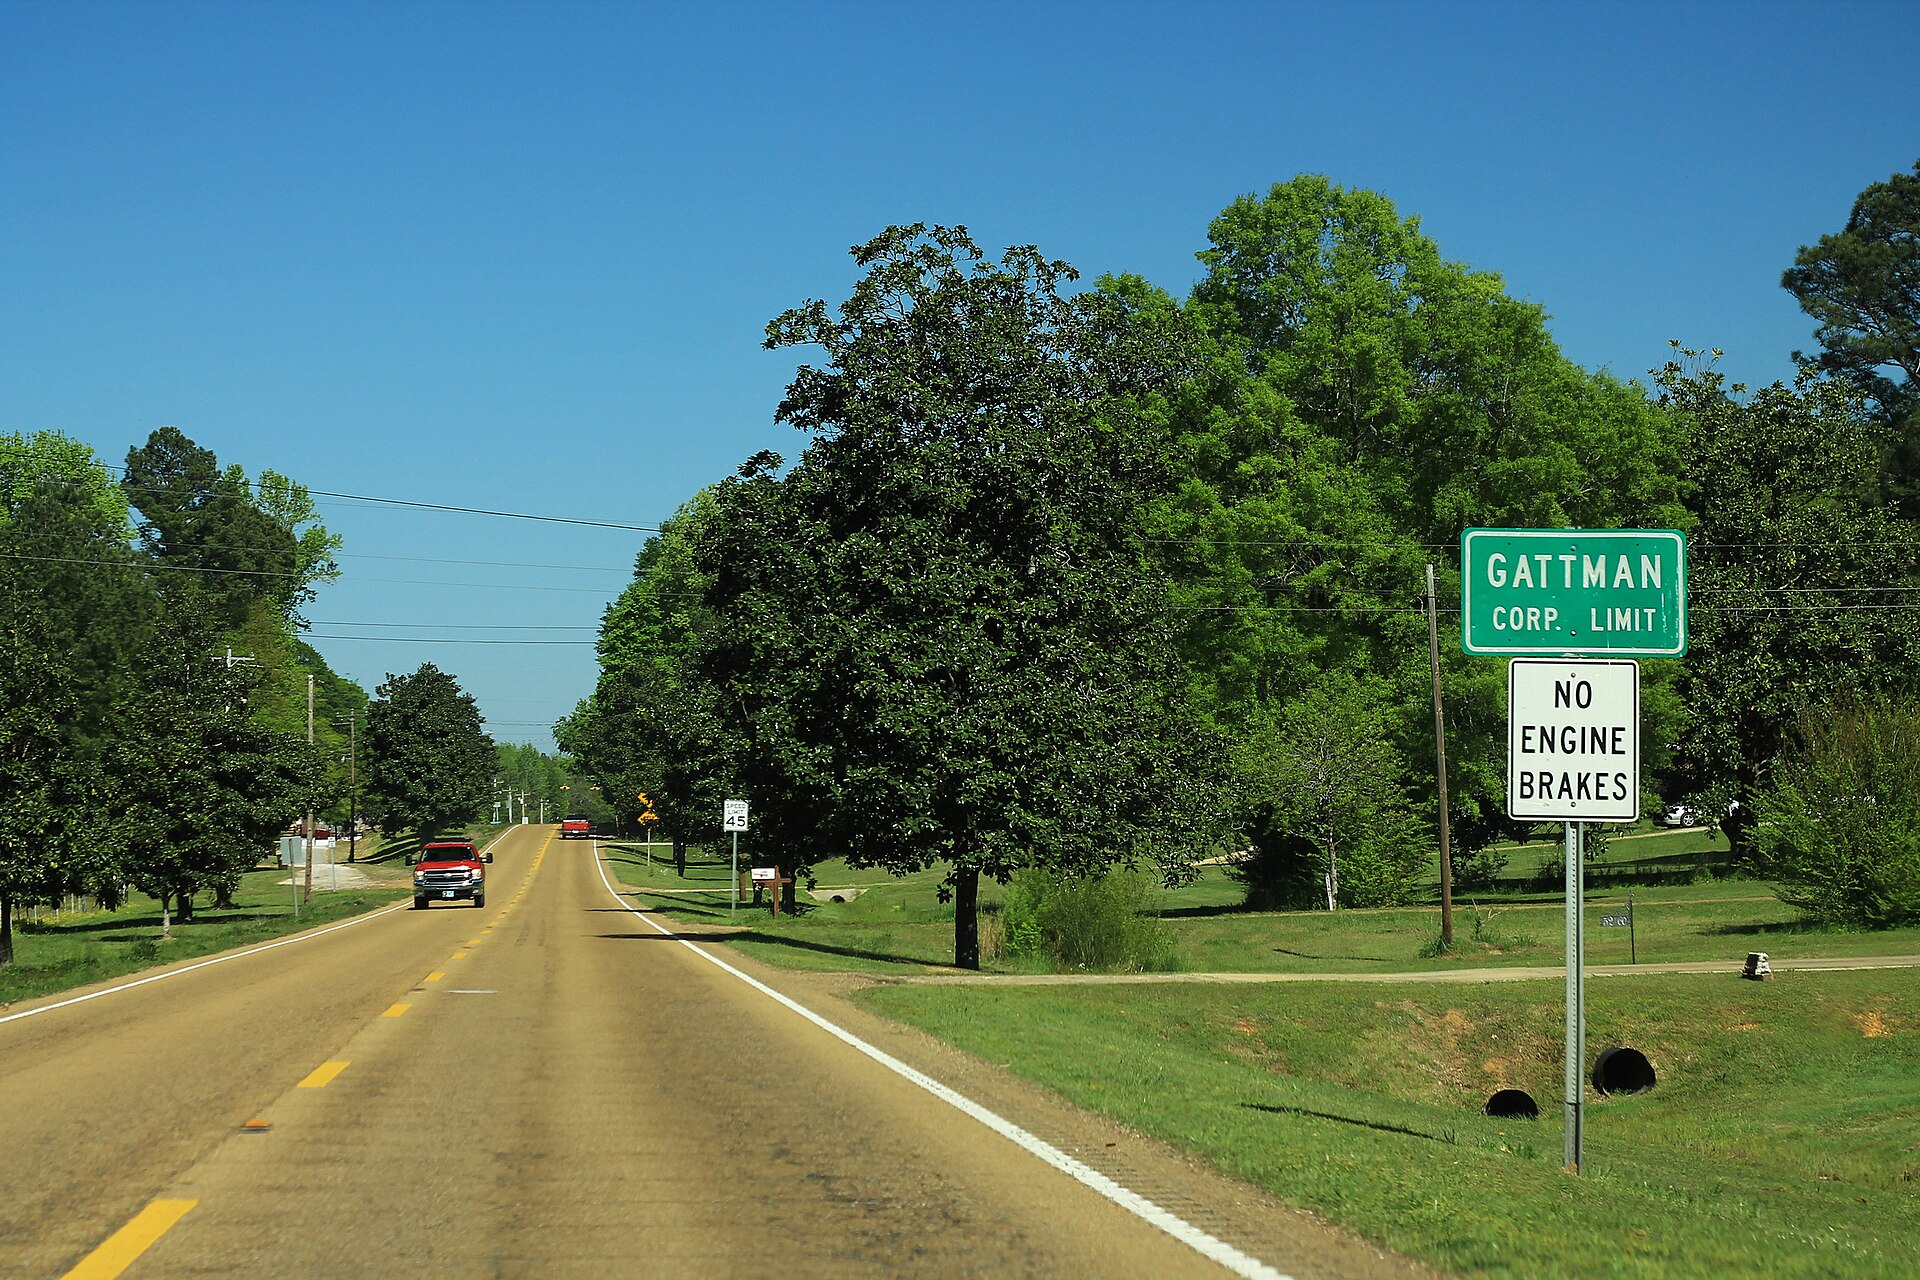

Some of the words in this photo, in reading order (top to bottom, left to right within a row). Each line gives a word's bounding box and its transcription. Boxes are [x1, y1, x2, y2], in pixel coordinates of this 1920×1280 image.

[1487, 553, 1662, 588] GATTMAN
[1492, 606, 1561, 631] CORP.
[1591, 608, 1656, 631] LIMIT
[1554, 680, 1592, 709] NO
[1521, 725, 1626, 755] ENGINE
[1519, 771, 1627, 800] BRAKES
[726, 816, 746, 827] 45
